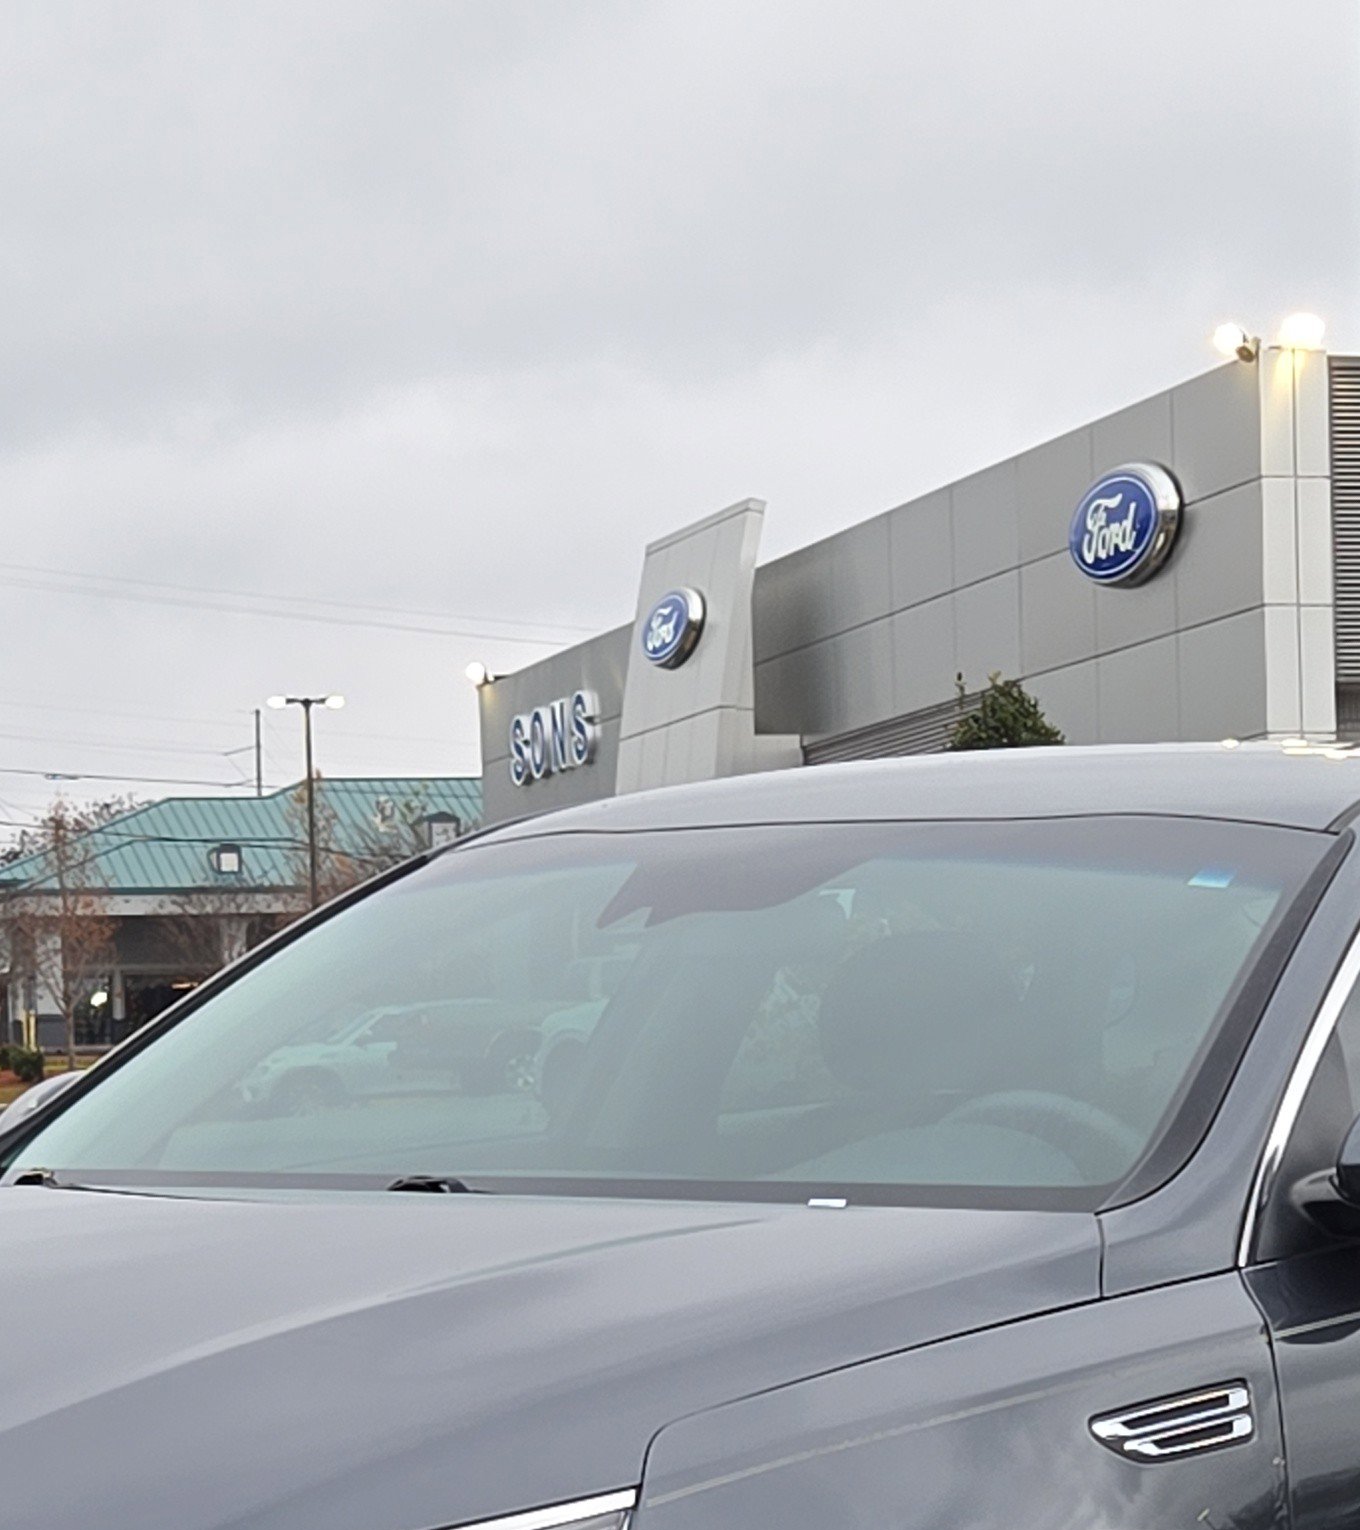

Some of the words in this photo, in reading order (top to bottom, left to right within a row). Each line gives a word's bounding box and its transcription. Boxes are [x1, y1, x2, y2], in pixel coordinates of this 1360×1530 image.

[1082, 493, 1137, 564] Ford
[646, 605, 679, 651] Ford
[510, 690, 596, 786] SONS
